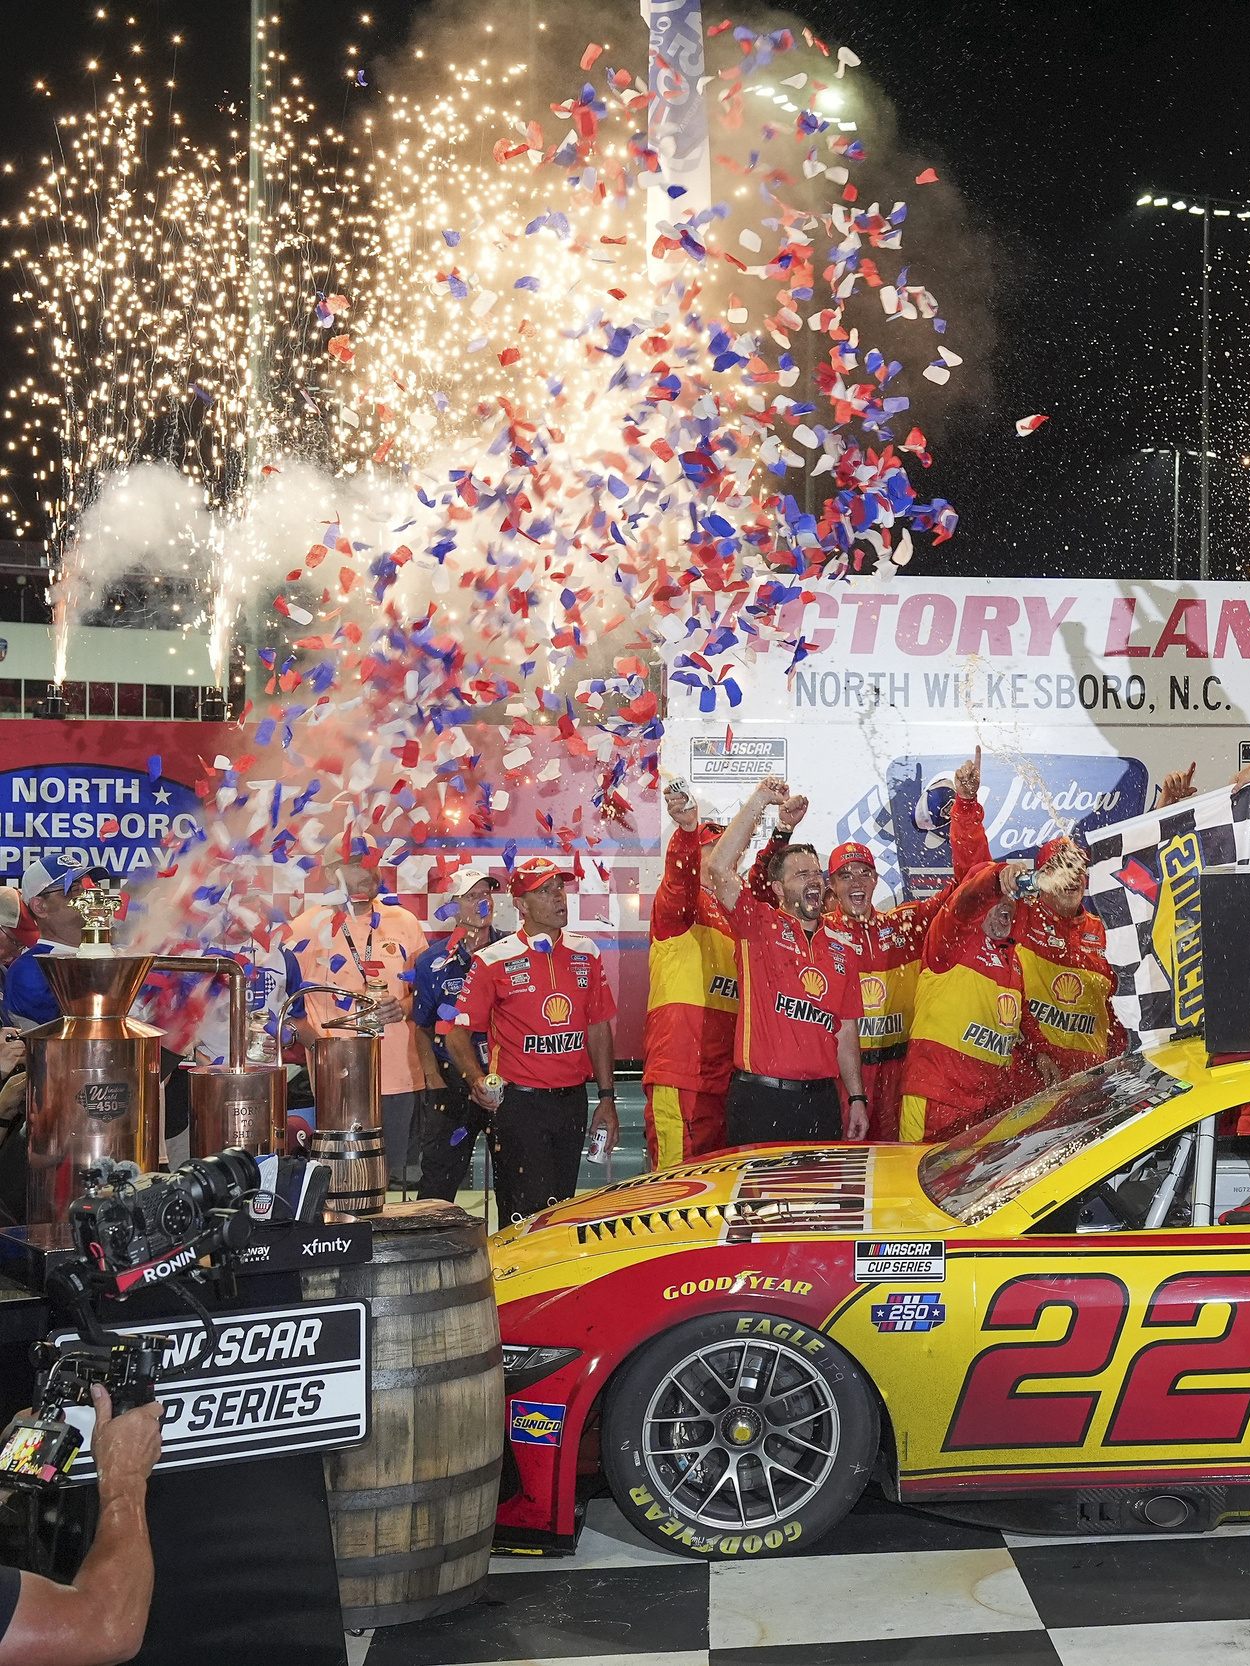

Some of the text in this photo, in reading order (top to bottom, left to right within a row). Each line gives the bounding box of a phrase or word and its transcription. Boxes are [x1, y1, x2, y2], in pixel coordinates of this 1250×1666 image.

[796, 671, 912, 708] NORTH
[1170, 674, 1232, 711] N.C.
[730, 761, 773, 773] SERIES
[12, 777, 140, 804] NORTH
[857, 1013, 903, 1037] NZOIL
[1028, 998, 1097, 1035] PENNZOIL
[962, 1022, 1016, 1057] PENNZ
[96, 1102, 118, 1112] 450
[233, 1106, 261, 1116] BORN
[242, 1119, 254, 1127] TO
[232, 1131, 254, 1139] SHI
[302, 1237, 352, 1257] xfinity
[884, 1244, 932, 1255] NASCAR
[143, 1247, 197, 1283] RONIN
[868, 1261, 932, 1272] CUP SERIES
[663, 1276, 813, 1300] GOODYEAR
[889, 1304, 929, 1320] 250
[735, 1318, 825, 1356] EAGLE
[187, 1379, 326, 1432] SERIES
[514, 1417, 562, 1433] SUNOCO
[629, 1484, 803, 1555] GOODYEAR
